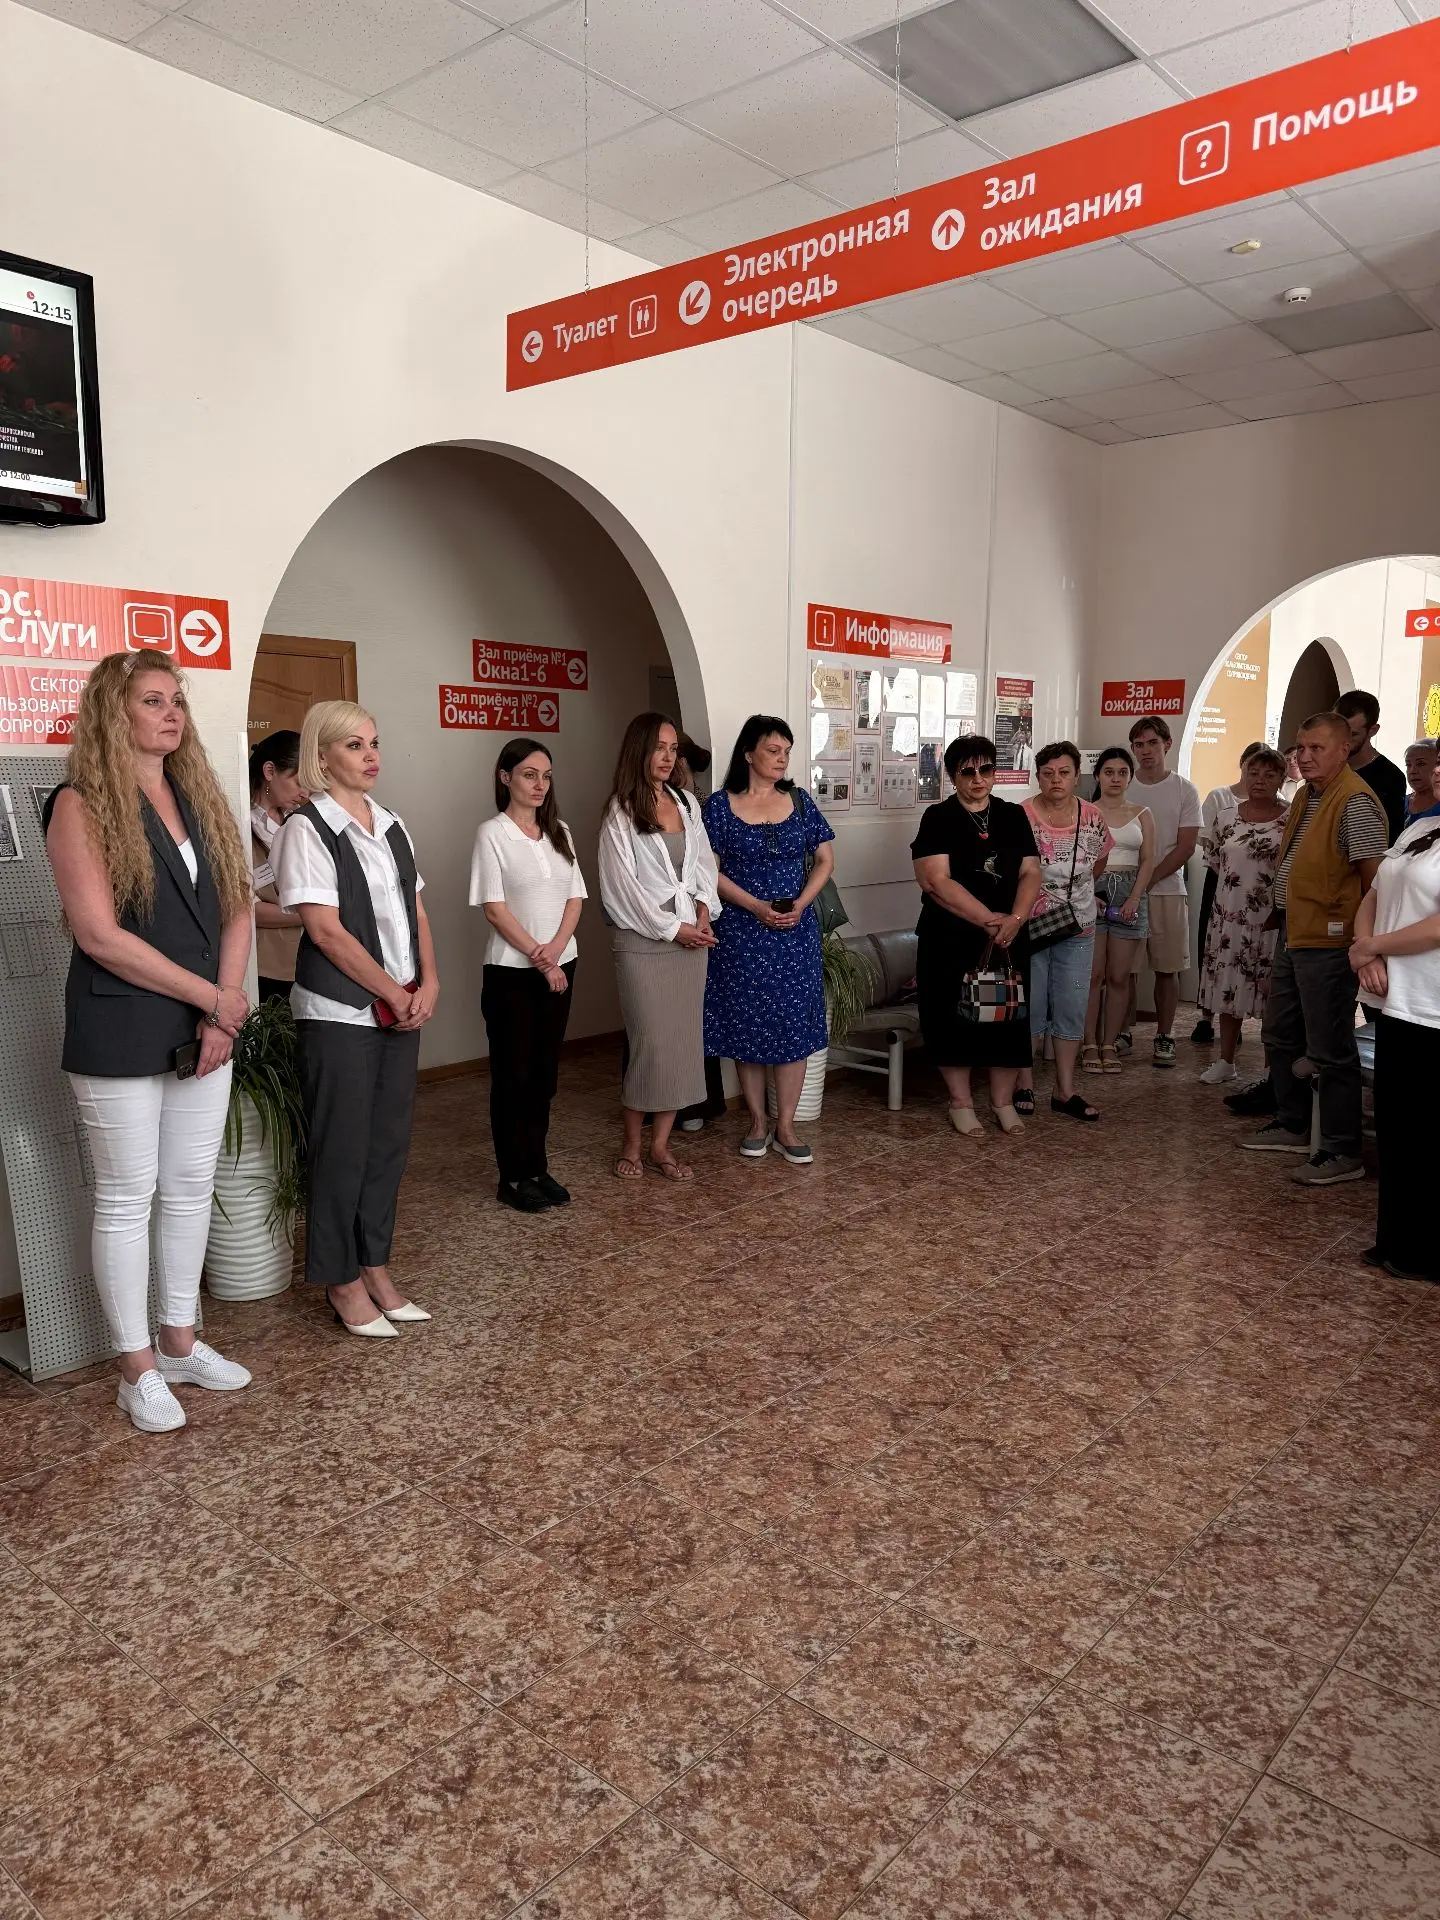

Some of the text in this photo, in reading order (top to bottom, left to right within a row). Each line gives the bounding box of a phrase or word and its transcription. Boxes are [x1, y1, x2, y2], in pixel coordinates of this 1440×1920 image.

[1252, 80, 1418, 151] Помощь
[982, 172, 1036, 210] Зал
[980, 183, 1143, 251] ожидания
[723, 208, 910, 286] Электронная
[31, 300, 72, 321] 12:15
[722, 273, 838, 323] очередь
[552, 313, 618, 353] Туалет
[0, 617, 97, 654] слуги
[845, 616, 943, 653] Информация
[478, 643, 567, 666] Зал приёма №1
[0, 696, 79, 714] ЛЬЗОВАТЕ
[444, 688, 538, 709] Зал приёма №2
[1125, 682, 1154, 699] Зал
[444, 704, 530, 727] Окна 7-11
[1104, 698, 1181, 714] ожидания
[247, 720, 271, 729] алет
